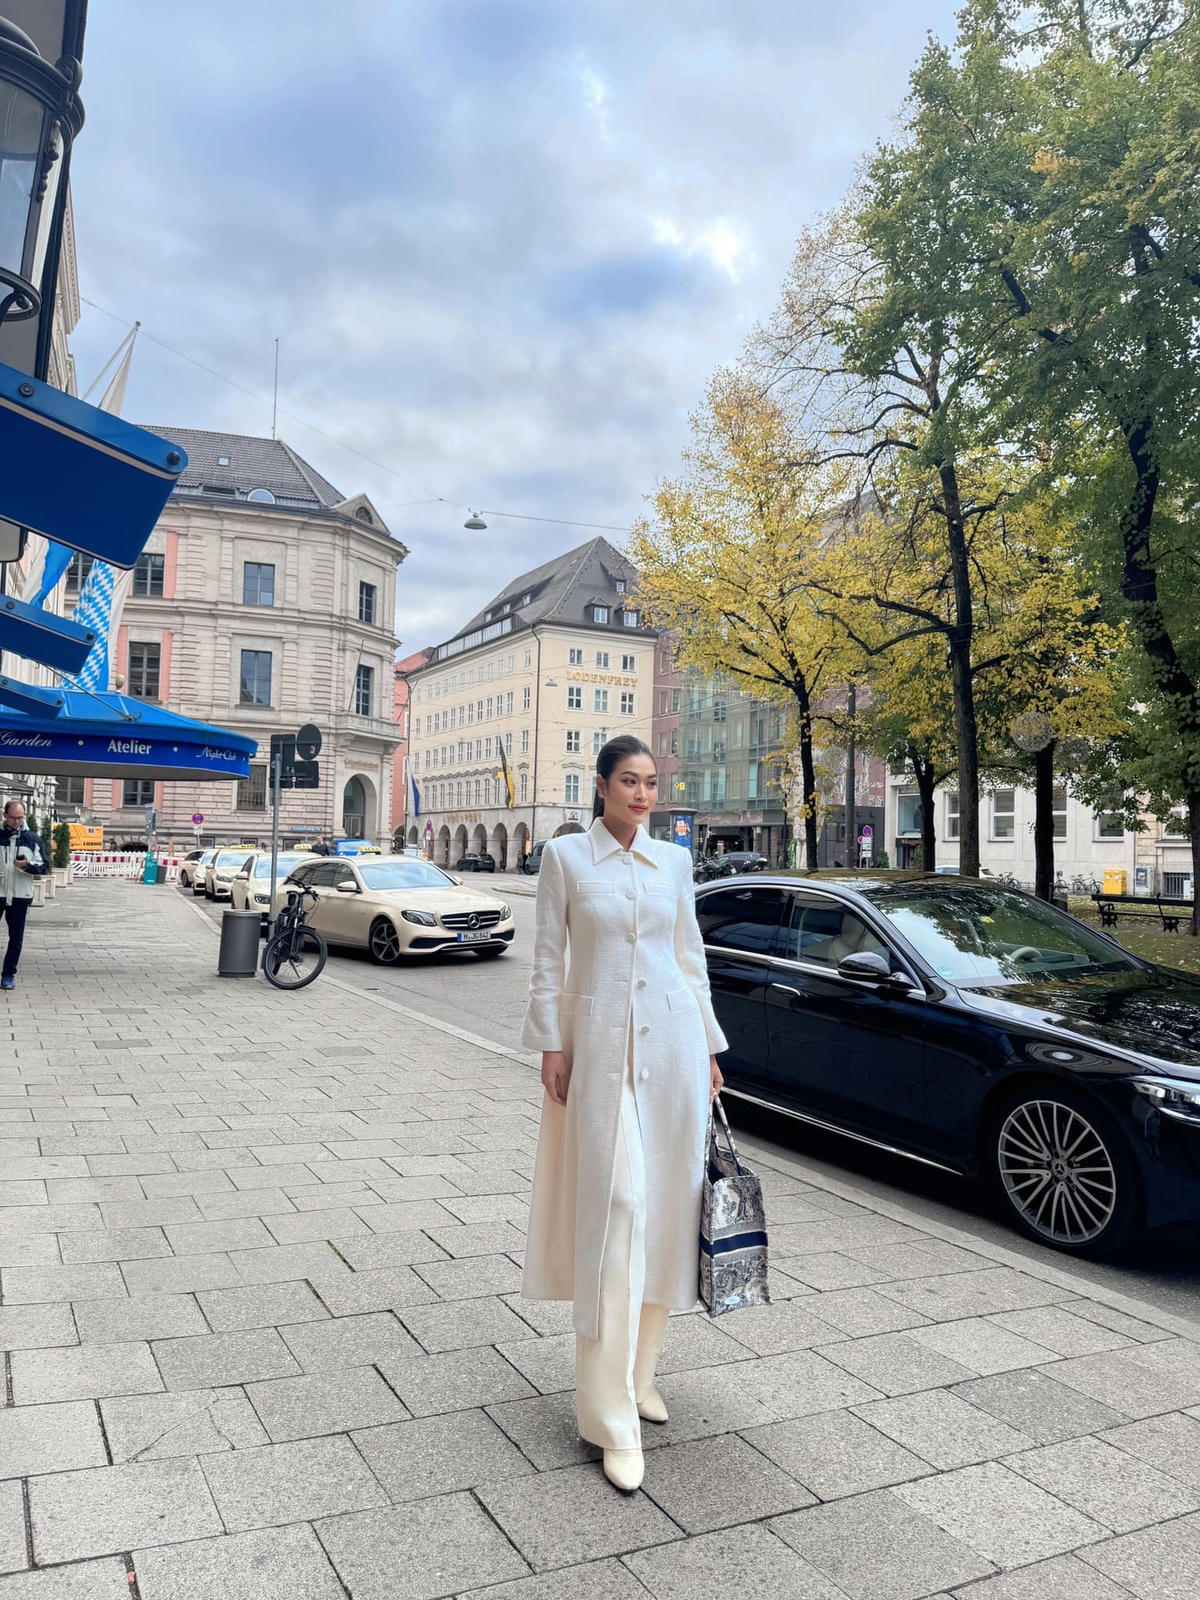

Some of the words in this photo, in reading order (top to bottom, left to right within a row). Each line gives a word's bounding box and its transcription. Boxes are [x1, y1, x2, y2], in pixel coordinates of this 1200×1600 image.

[566, 670, 638, 688] LODENFREY
[0, 731, 52, 747] Garden
[107, 739, 152, 755] Atelier
